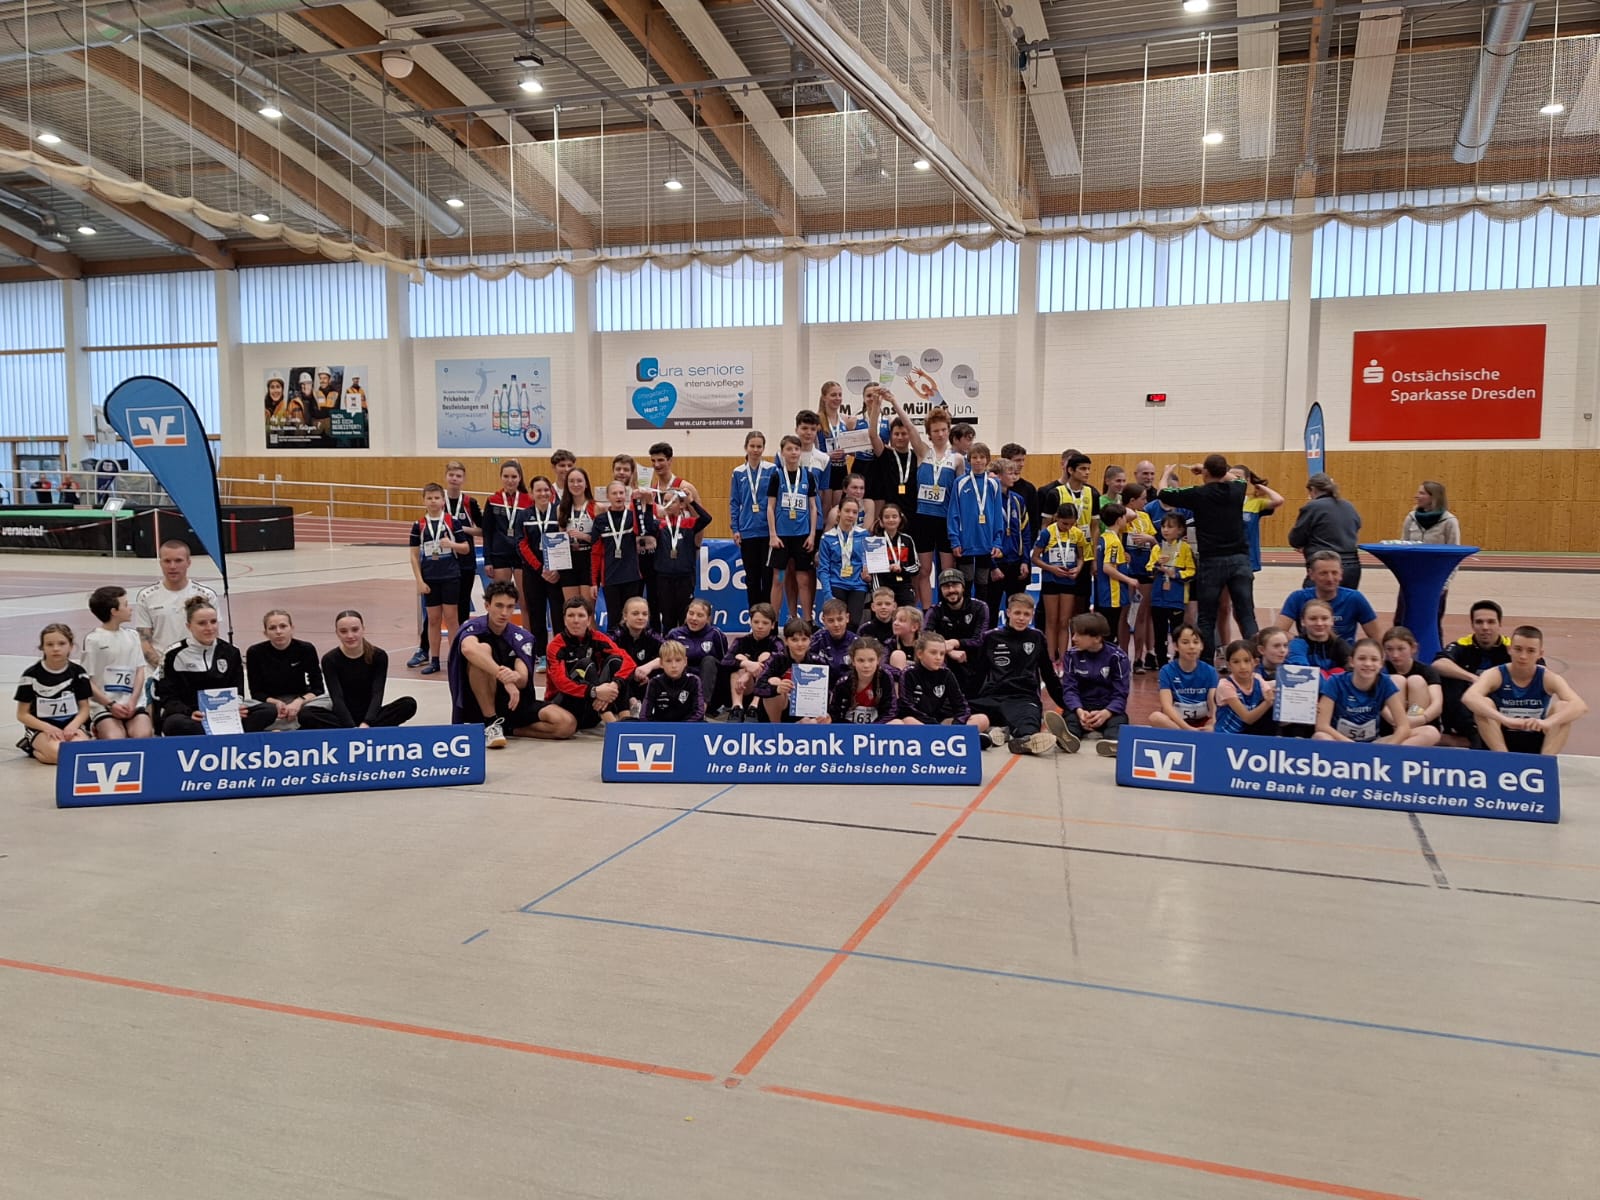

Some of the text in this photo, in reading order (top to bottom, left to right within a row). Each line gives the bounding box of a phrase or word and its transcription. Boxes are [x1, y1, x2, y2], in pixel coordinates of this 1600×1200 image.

[647, 363, 744, 377] cura seniore
[1391, 368, 1500, 383] Ostsächsische
[685, 379, 744, 388] intensivpflege
[1391, 387, 1536, 404] Sparkasse Dresden
[953, 404, 975, 416] jun.
[674, 419, 744, 427] www.cura-seniore.de
[116, 673, 131, 685] 76
[49, 703, 68, 716] 74
[1183, 710, 1198, 719] 51
[850, 711, 872, 724] 163
[703, 733, 967, 757] Volksbank Pirna eG
[177, 735, 471, 772] Volksbank Pirna eG
[706, 763, 967, 774] Ihre Bank in der Sächsischen Schweiz
[1226, 747, 1545, 793] Volksbank Pirna eG
[181, 765, 470, 791] Ihre Bank in der Sächsischen Schweiz
[1230, 778, 1545, 813] Ihre Bank in der Sächsischen Schweiz
